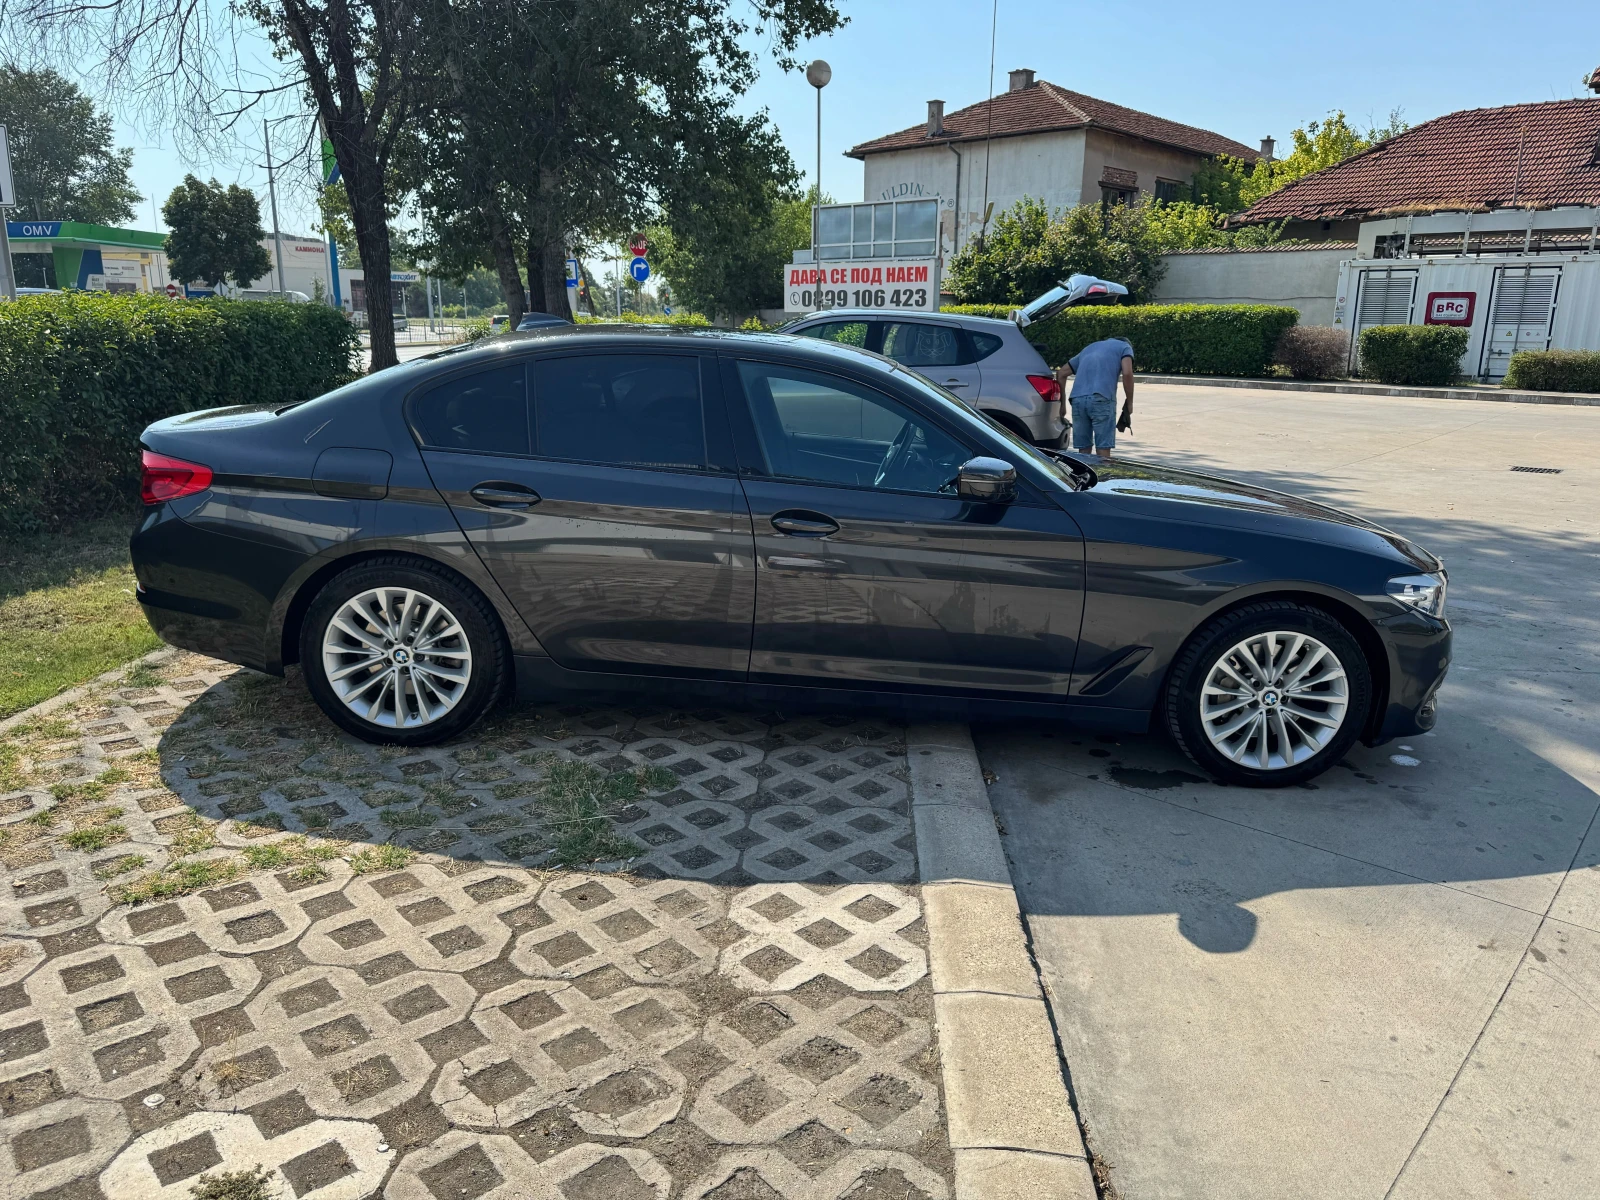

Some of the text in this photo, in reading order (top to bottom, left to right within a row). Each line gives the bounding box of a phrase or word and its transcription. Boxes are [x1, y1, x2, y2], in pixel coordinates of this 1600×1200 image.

[22, 225, 52, 236] OMV
[790, 266, 928, 286] ДАВА СЕ ПОД НАЕМ
[852, 289, 886, 307] 106
[890, 288, 927, 307] 423
[1436, 302, 1464, 313] BRC
[345, 571, 396, 588] KUMHO
